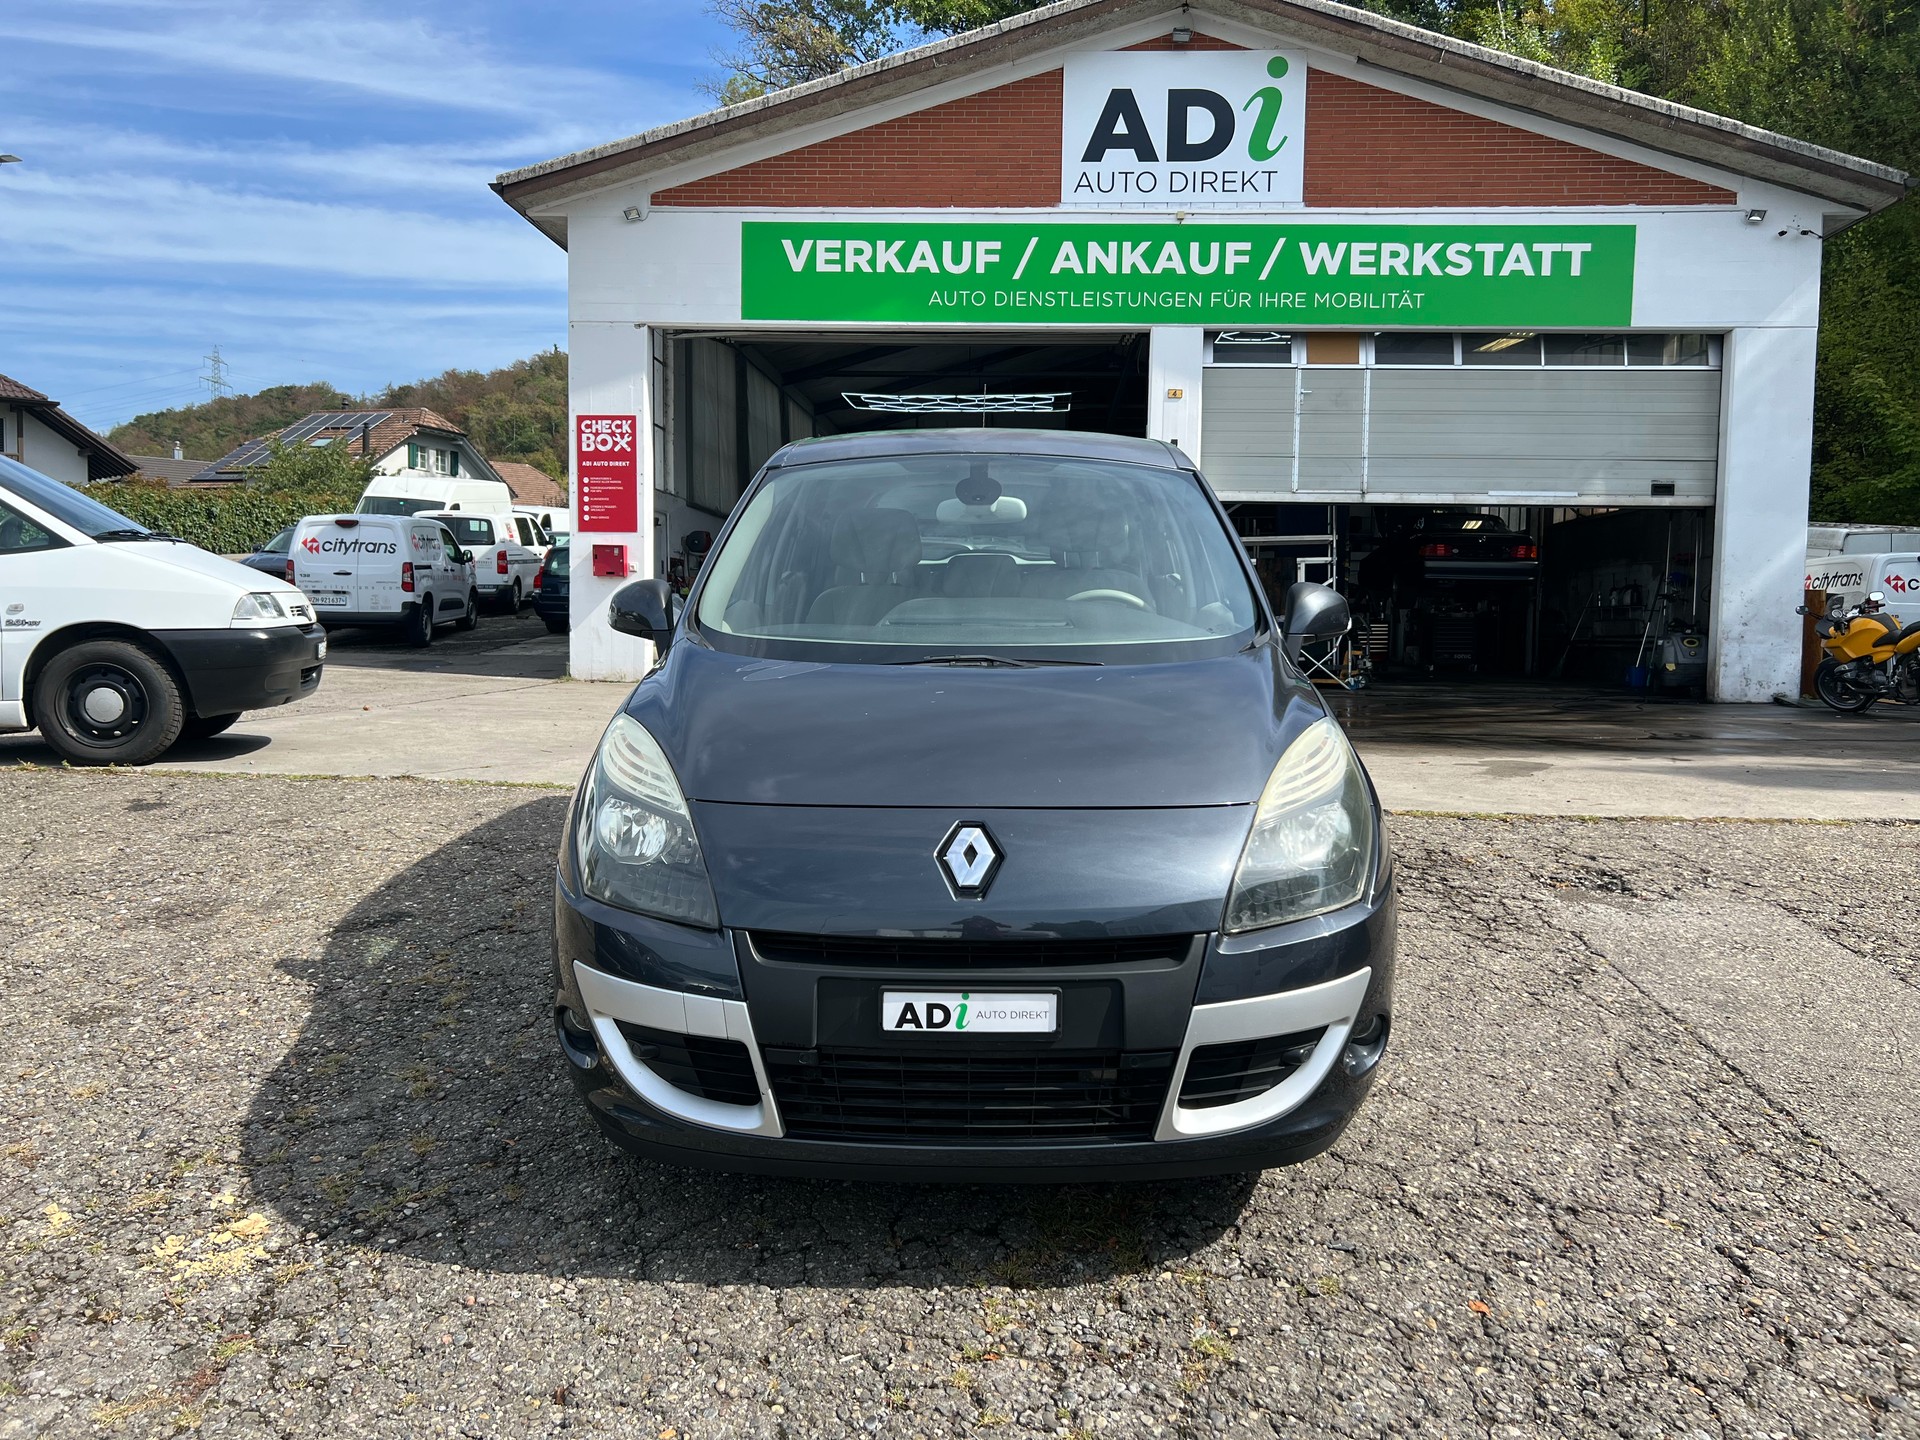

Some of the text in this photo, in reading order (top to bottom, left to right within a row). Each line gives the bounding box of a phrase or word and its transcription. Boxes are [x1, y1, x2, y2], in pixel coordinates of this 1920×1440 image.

[1074, 171, 1278, 193] AUTO DIREKT
[781, 239, 1001, 274] VERKAUF
[1050, 241, 1252, 275] ANKAUF
[1299, 242, 1592, 276] WERKSTATT
[928, 289, 1426, 310] AUTO DIENSTLEISTUNGEN FÜR IHRE MOBILITÄT
[581, 419, 632, 433] CHECK
[581, 433, 633, 452] BOX
[322, 537, 397, 556] citytrans
[1811, 571, 1863, 591] citytrans
[976, 1010, 1007, 1020] AUTO
[1010, 1011, 1049, 1020] DIREKT
